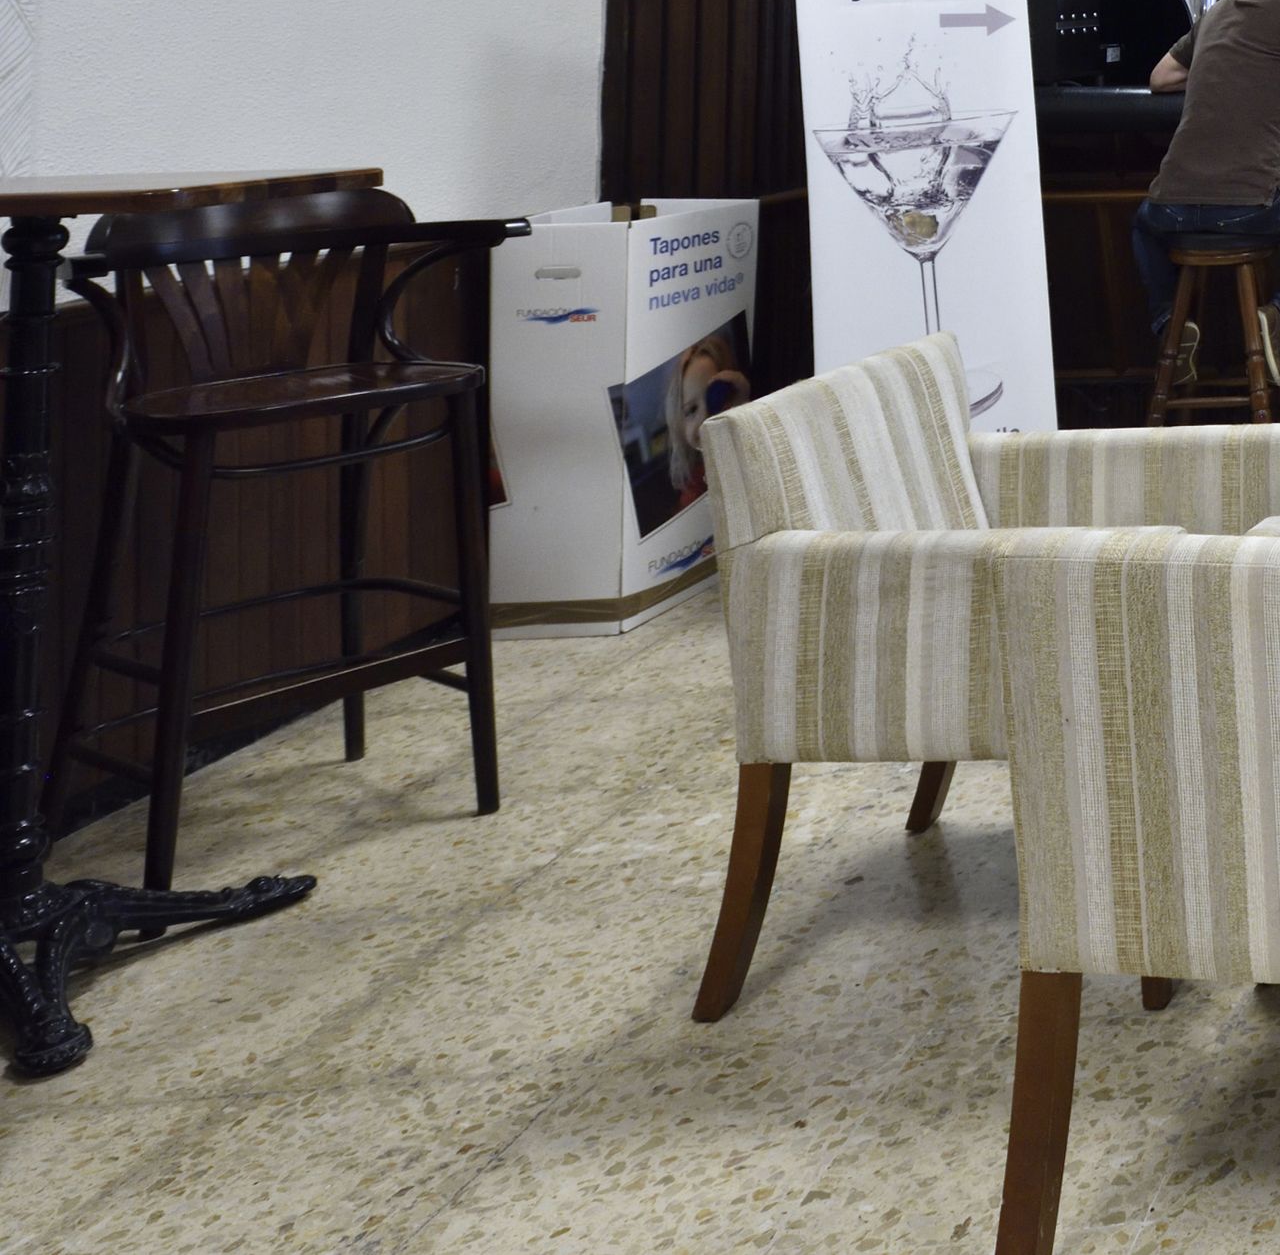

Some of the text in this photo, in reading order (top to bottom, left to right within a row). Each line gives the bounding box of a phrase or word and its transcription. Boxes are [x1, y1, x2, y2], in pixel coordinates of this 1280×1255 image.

[649, 230, 720, 256] Tapones
[649, 255, 723, 287] para una
[649, 286, 701, 310] nueva
[569, 314, 597, 323] SEUR
